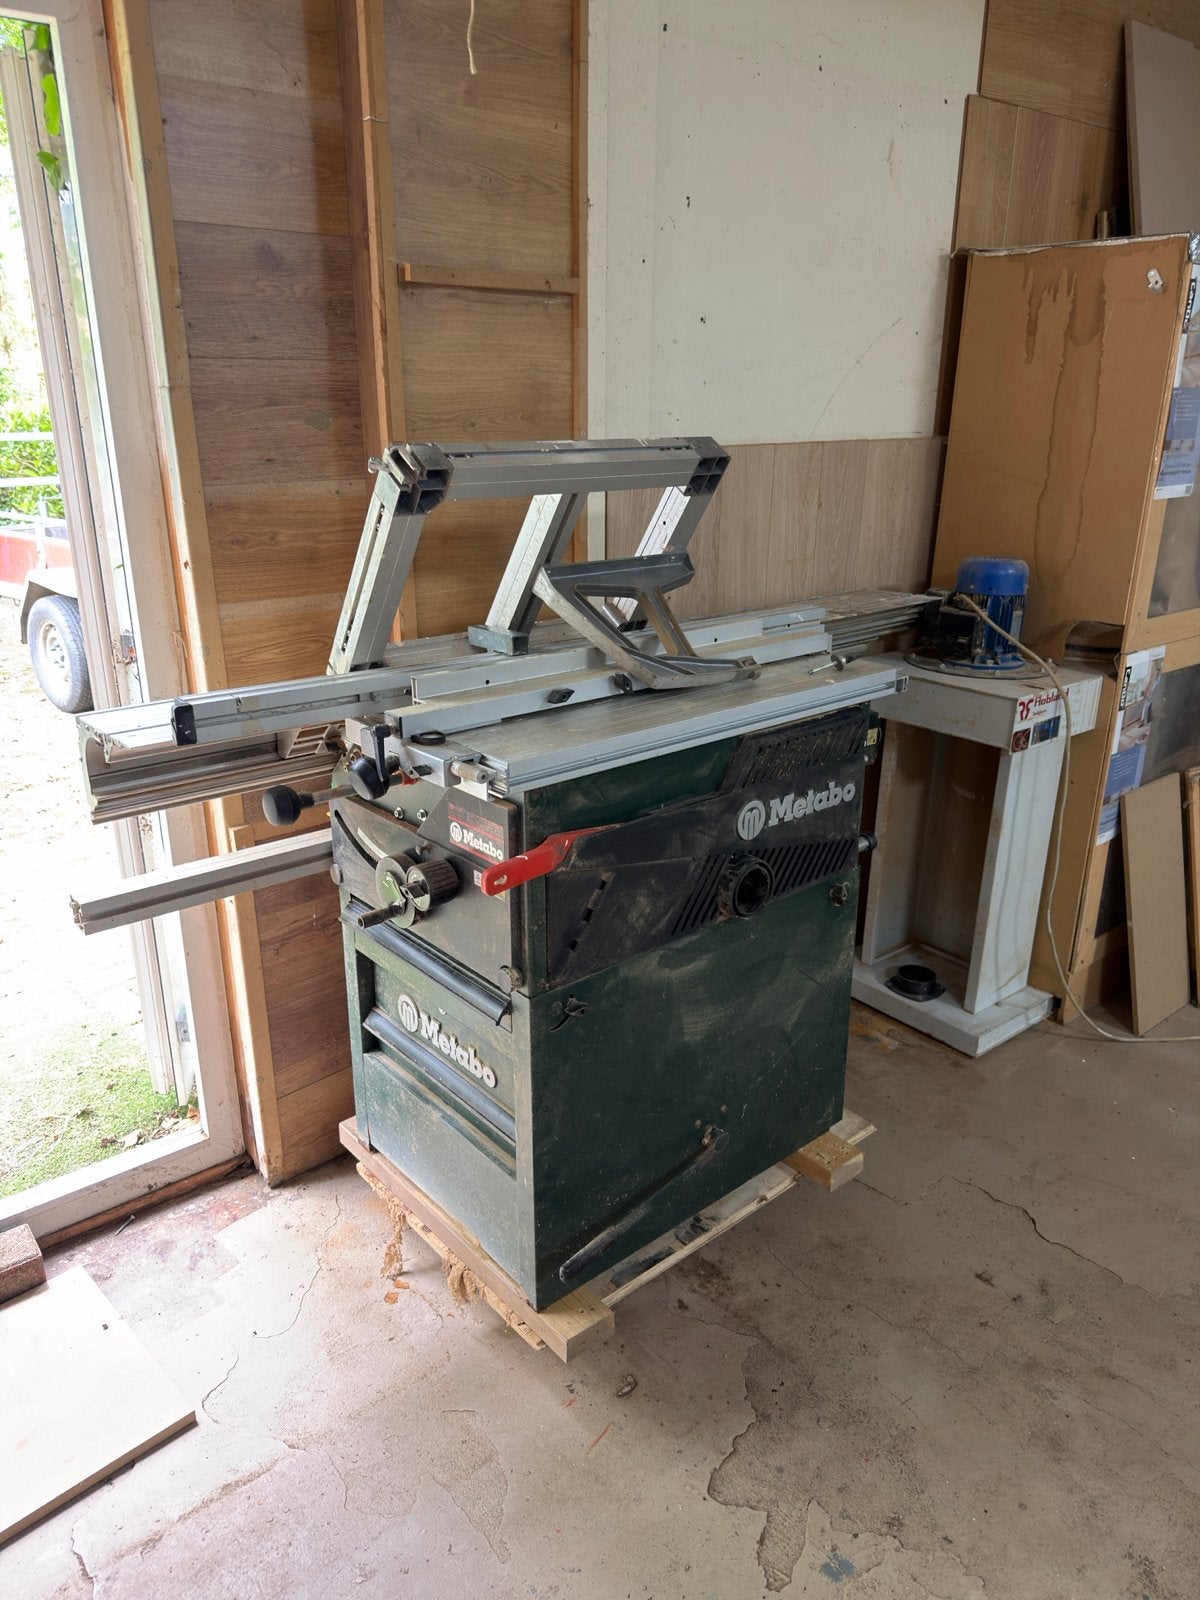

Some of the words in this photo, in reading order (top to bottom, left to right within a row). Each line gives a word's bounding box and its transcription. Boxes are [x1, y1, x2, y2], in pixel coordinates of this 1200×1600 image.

[768, 781, 856, 827] Metabo
[462, 829, 504, 861] Metabo
[419, 1014, 498, 1088] Metabo
